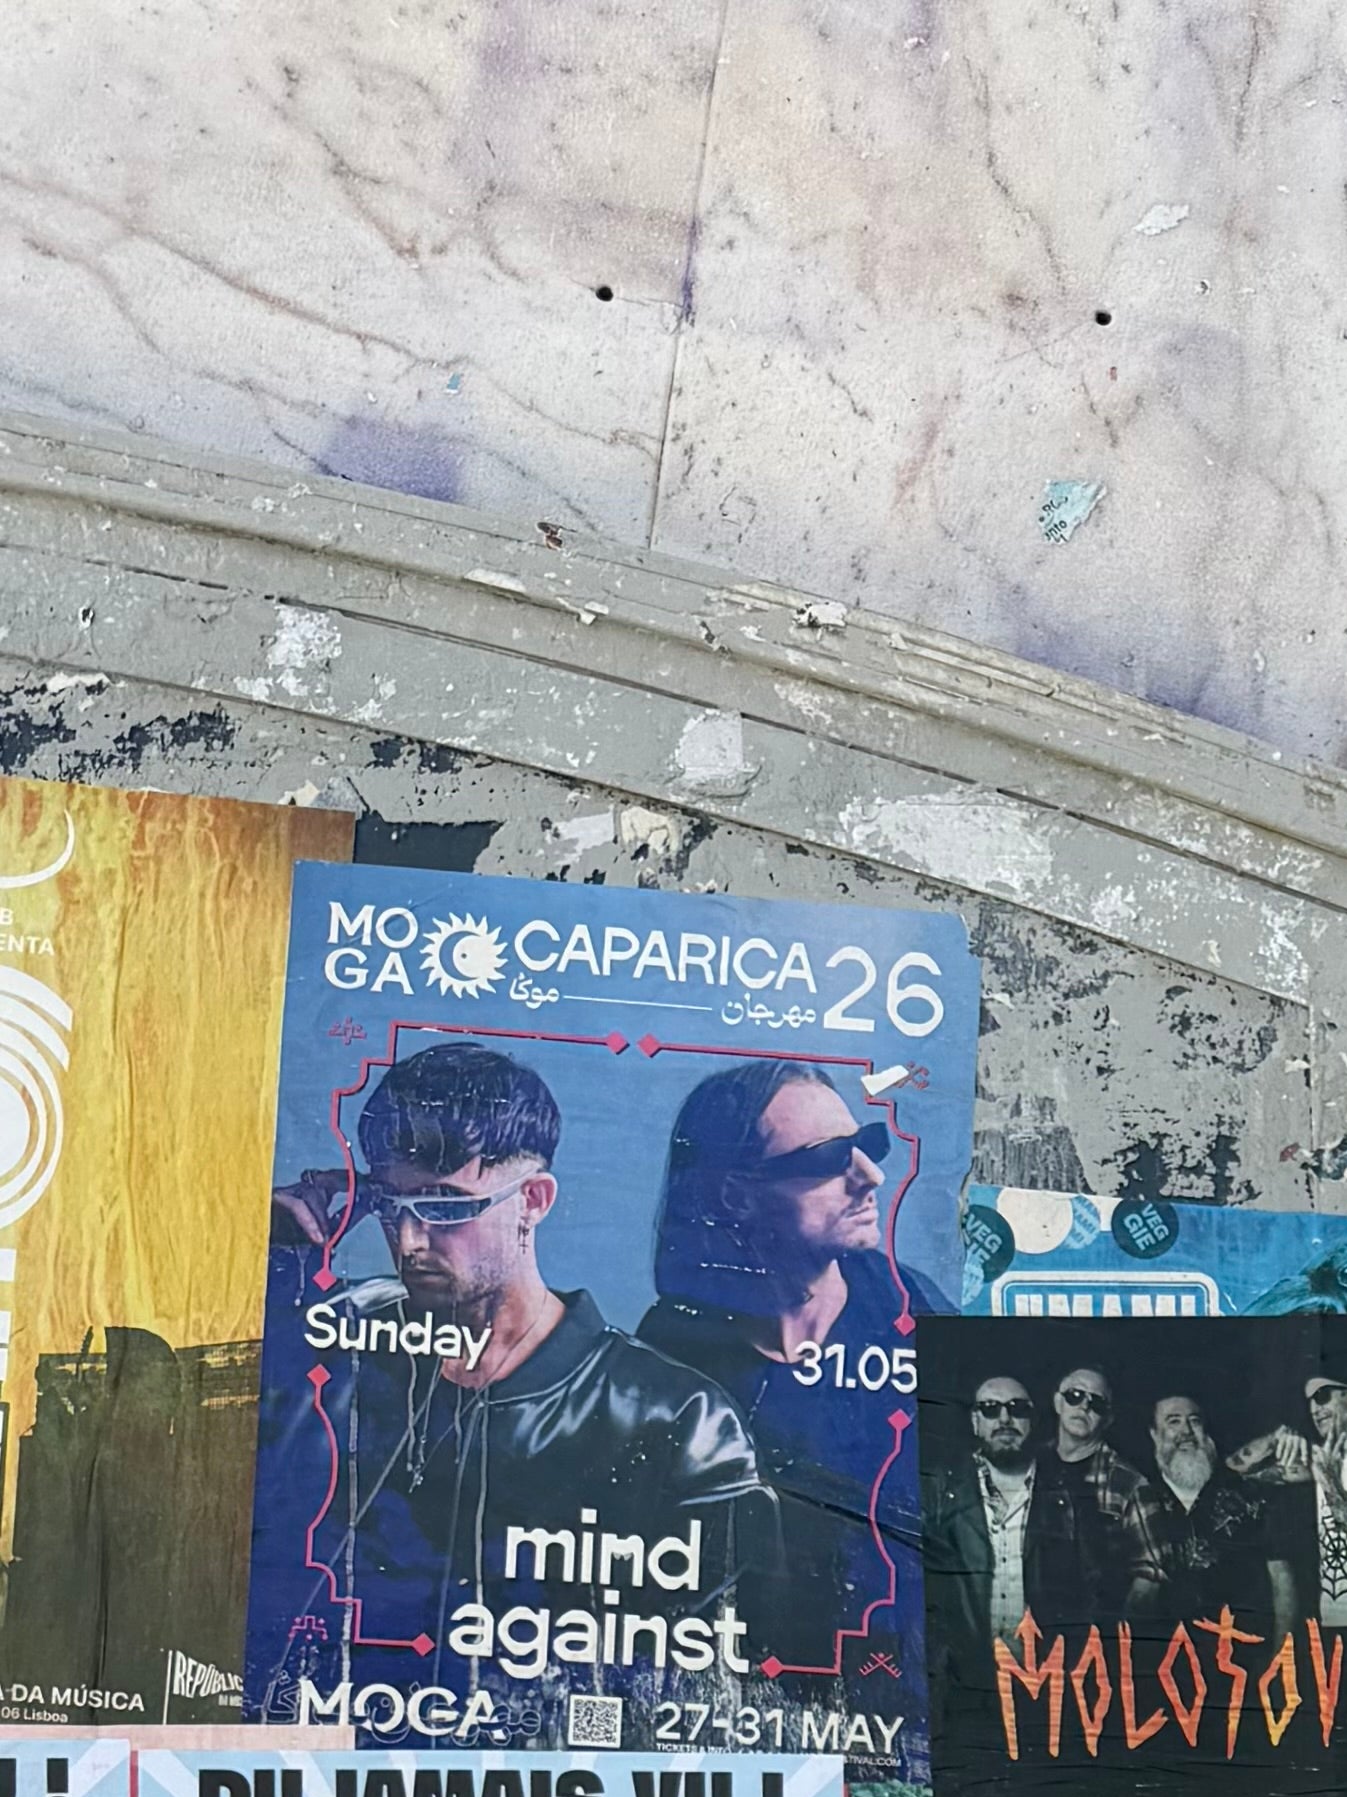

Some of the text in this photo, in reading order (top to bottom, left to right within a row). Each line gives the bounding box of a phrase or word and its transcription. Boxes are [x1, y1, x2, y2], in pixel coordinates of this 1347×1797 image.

[514, 919, 944, 1038] CAPARICA 26
[1123, 1214, 1156, 1251] GIE
[1142, 1203, 1169, 1242] VEG
[305, 1303, 492, 1371] Sunday
[793, 1341, 917, 1395] 31.05
[505, 1508, 702, 1592] mind
[449, 1590, 750, 1679] against
[12, 1683, 144, 1712] DA MÚSICA
[300, 1679, 509, 1742] MOGA
[994, 1604, 1344, 1761] MOLOTOV
[655, 1701, 904, 1754] 27-31 MAY
